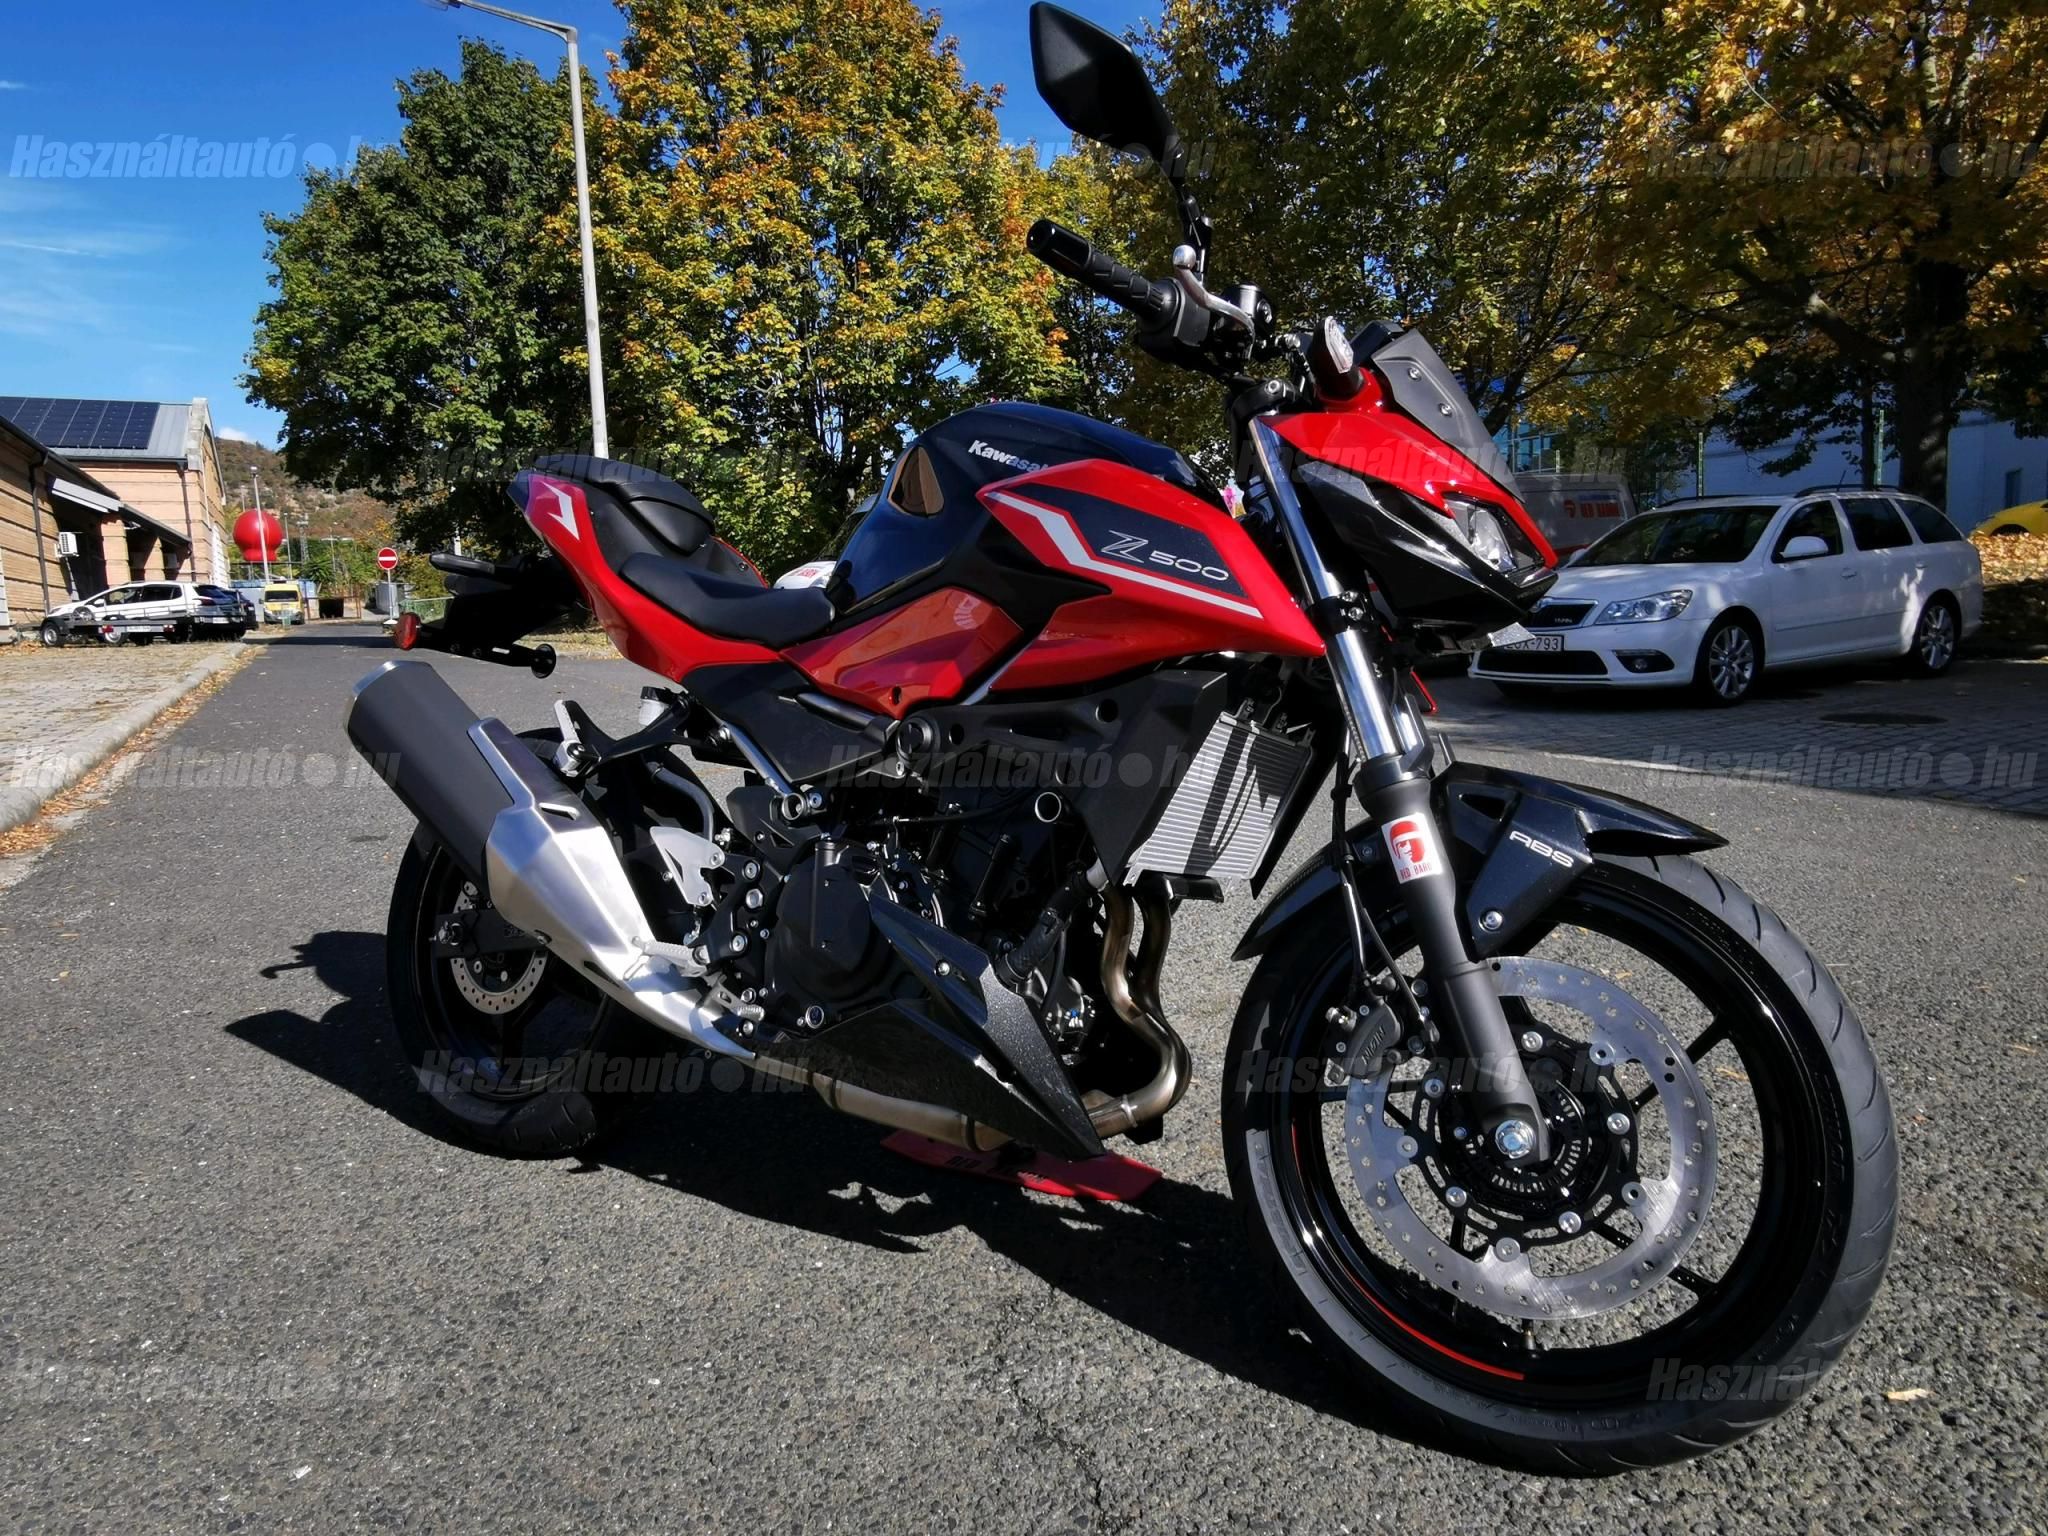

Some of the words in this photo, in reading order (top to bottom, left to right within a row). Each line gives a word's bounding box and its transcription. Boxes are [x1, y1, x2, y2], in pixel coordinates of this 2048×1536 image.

[1101, 529, 1149, 564] Z
[1148, 550, 1229, 581] 500
[1509, 830, 1575, 868] ABS
